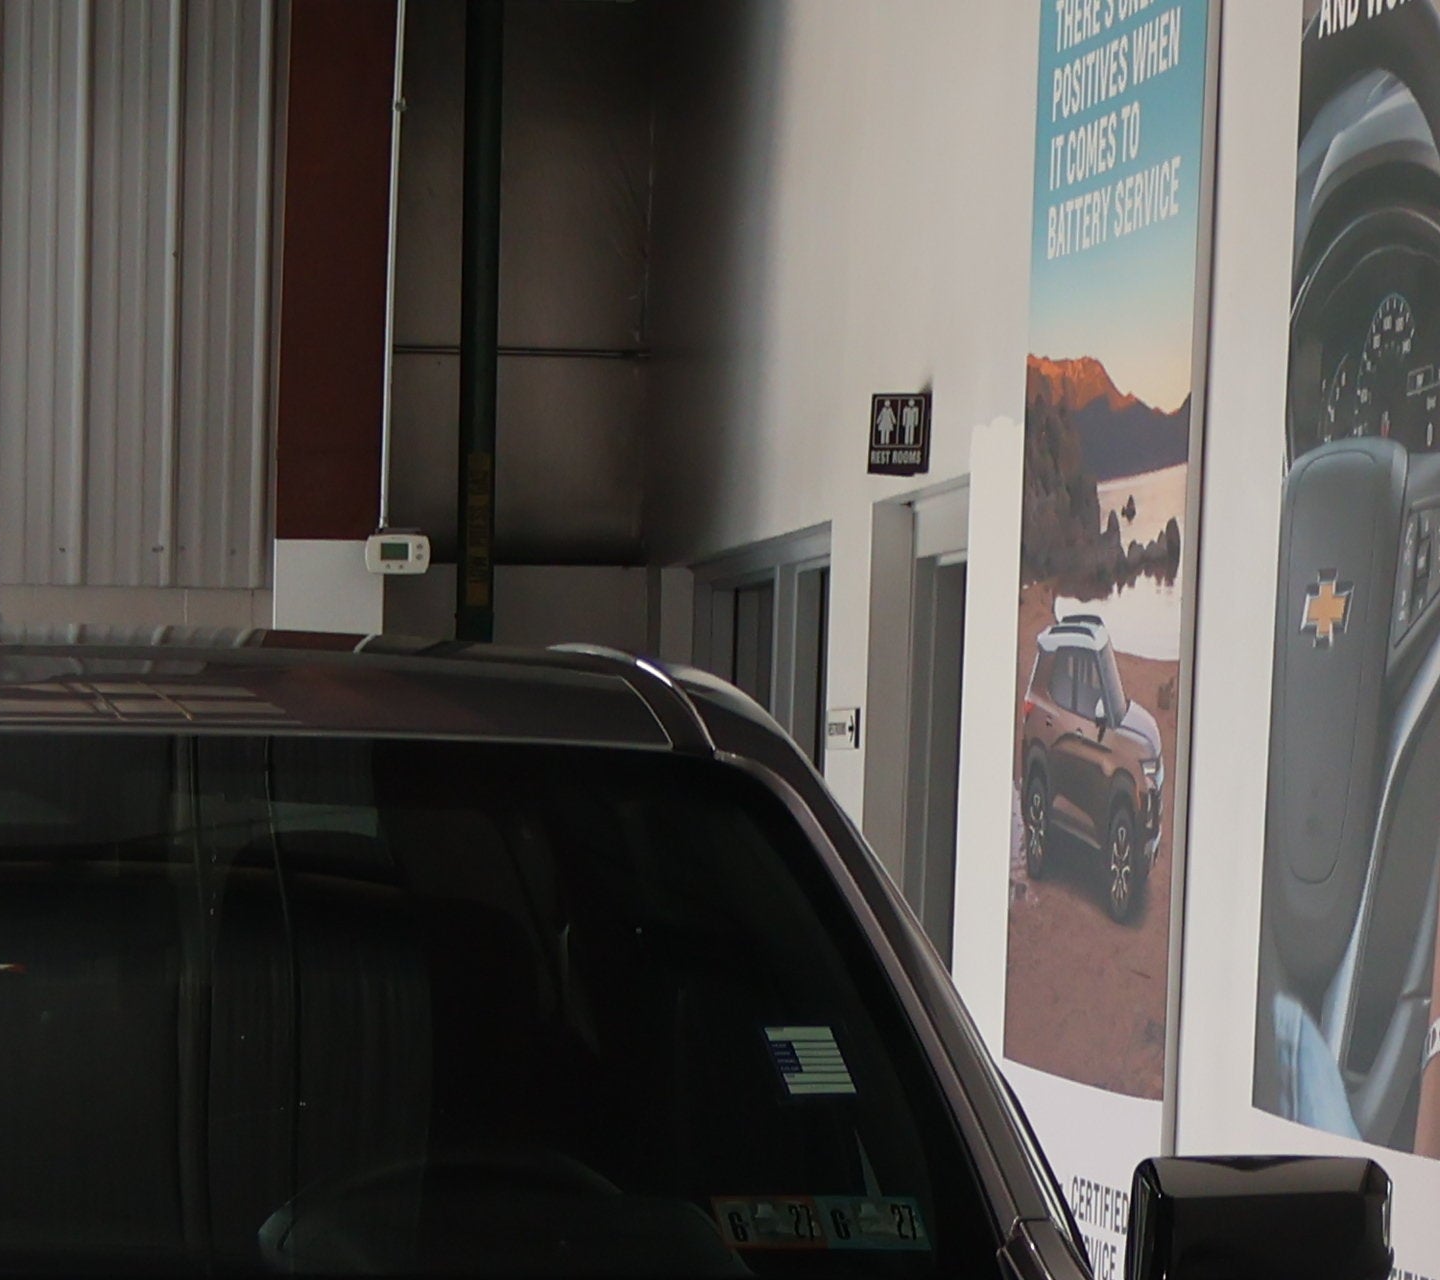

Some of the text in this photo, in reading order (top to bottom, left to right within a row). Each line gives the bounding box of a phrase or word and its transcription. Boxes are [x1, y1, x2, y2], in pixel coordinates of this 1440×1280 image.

[1056, 0, 1115, 53] THERES
[1052, 6, 1181, 122] POSITIVES WHEN
[1050, 101, 1141, 191] IT COMES TO
[1047, 156, 1182, 260] BATTERY SERVICE
[870, 450, 891, 464] REST
[1071, 1176, 1129, 1235] CERTIFIED
